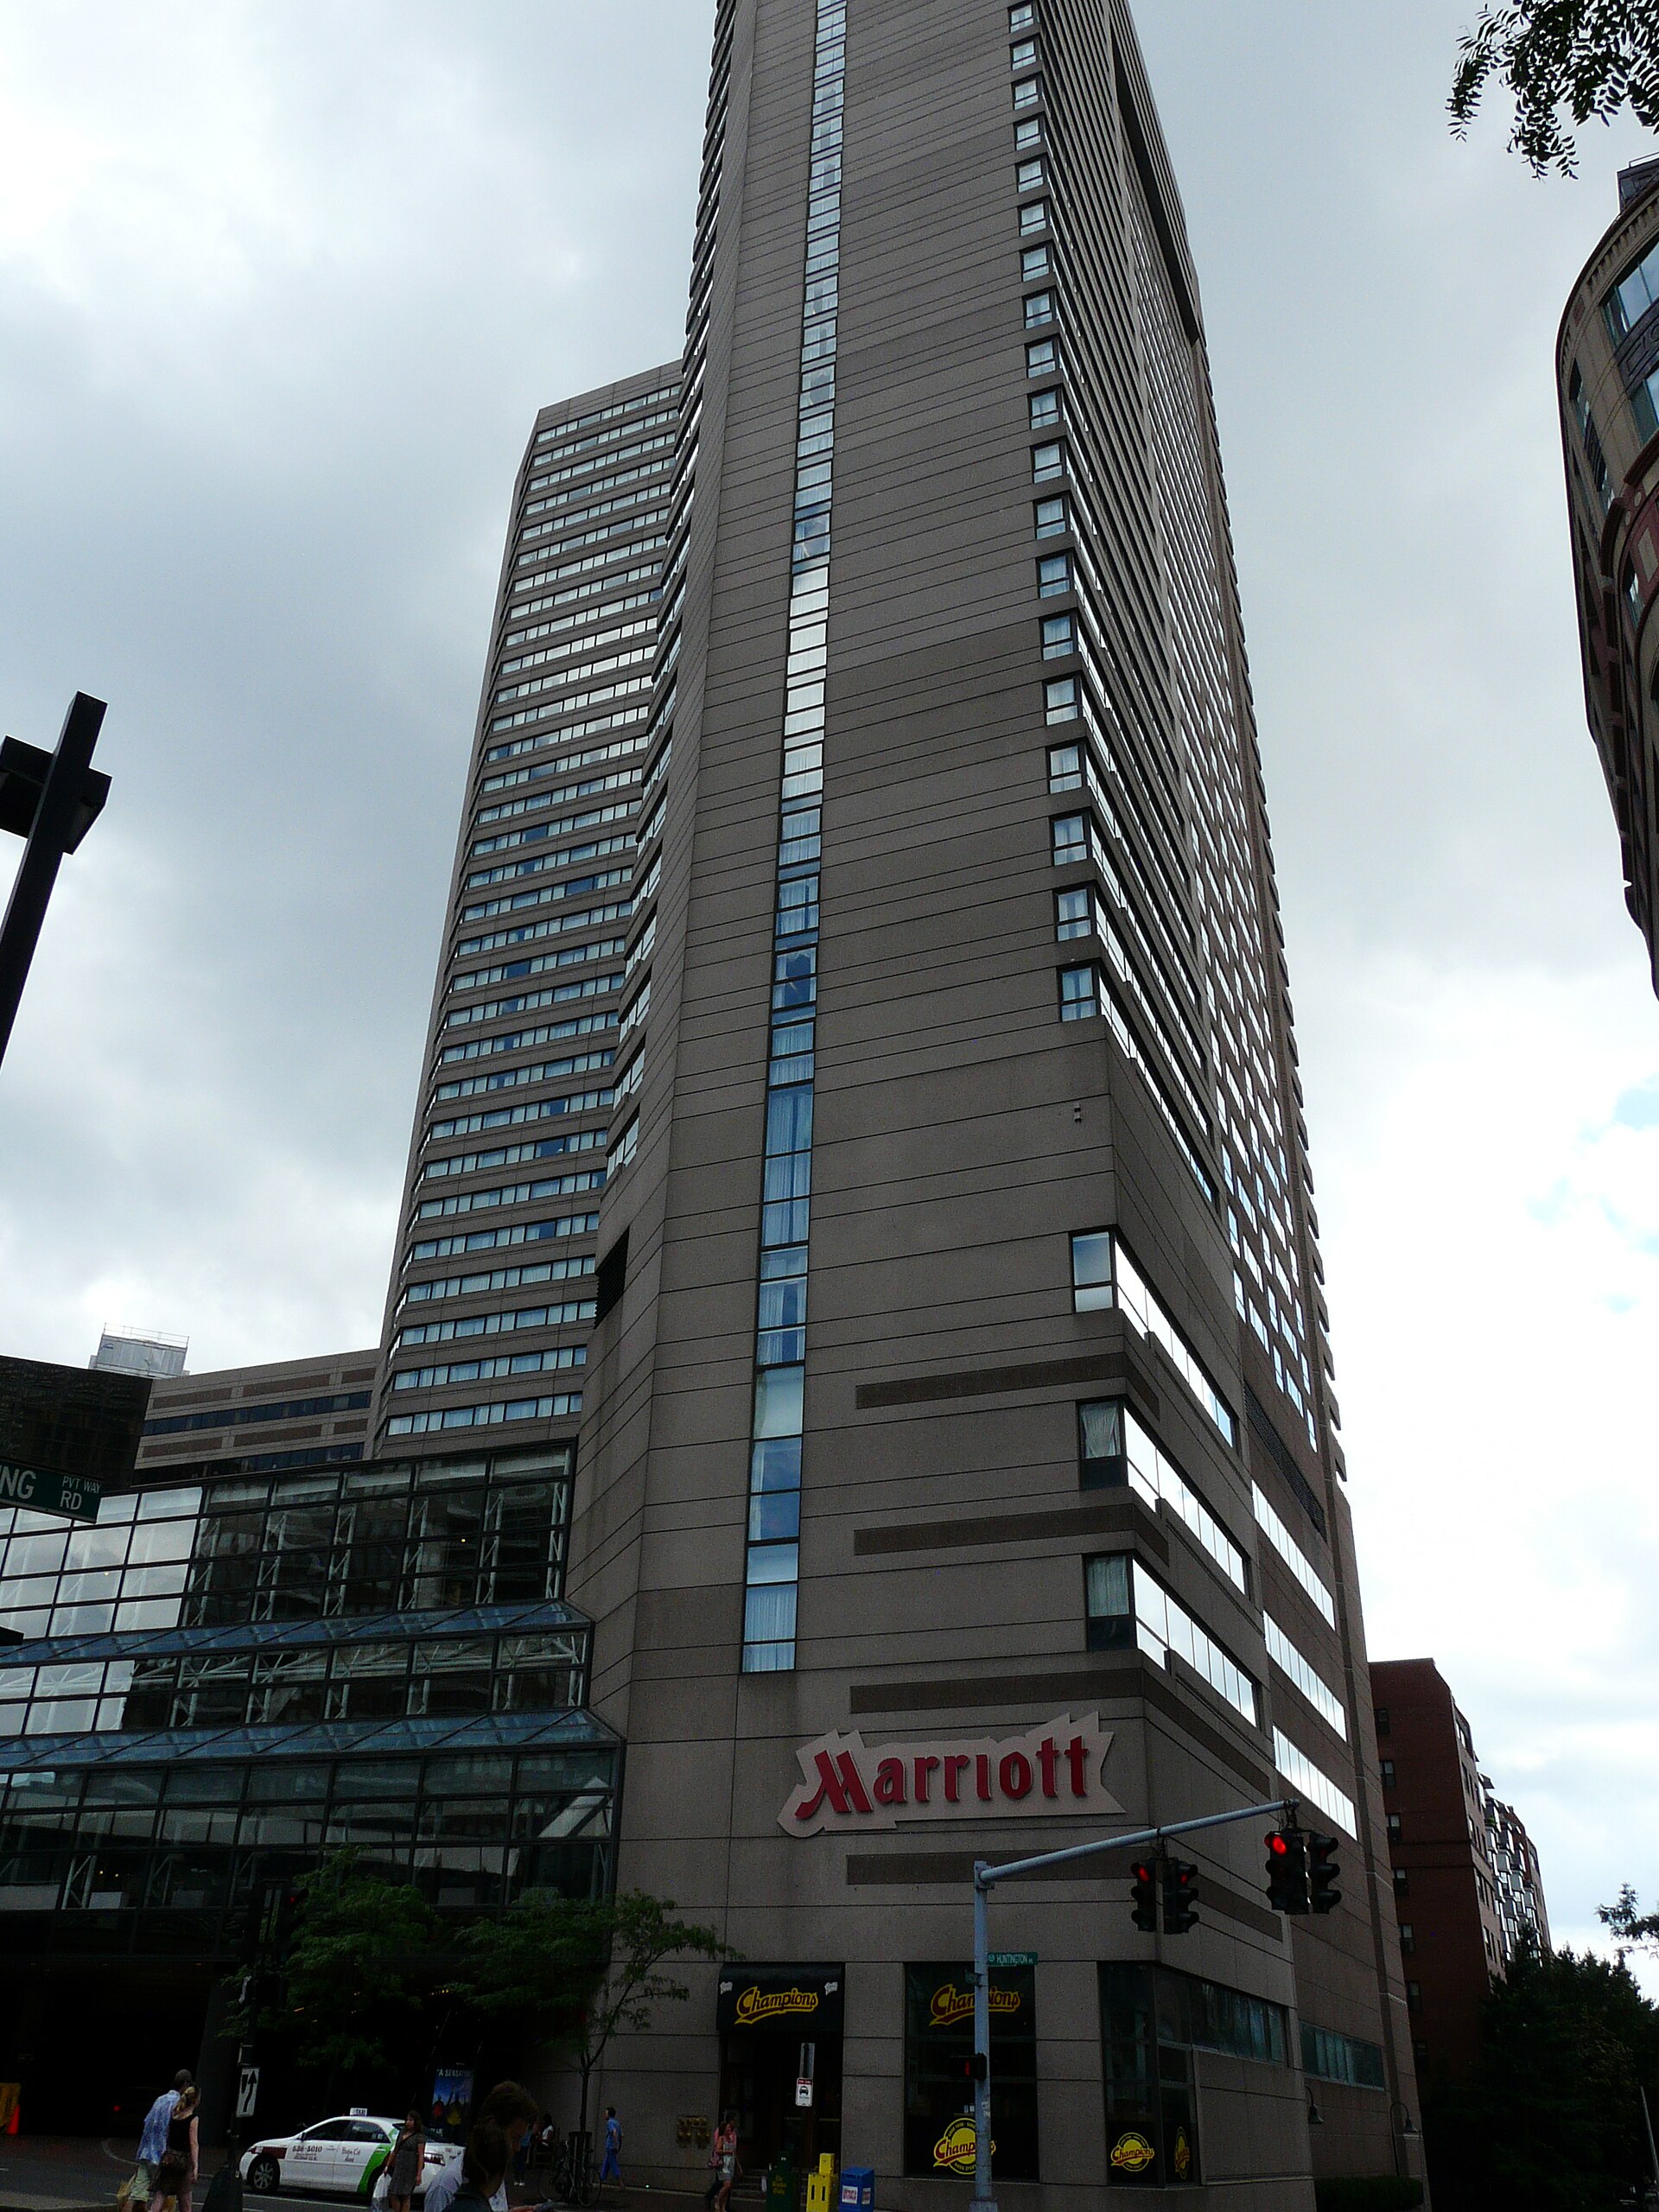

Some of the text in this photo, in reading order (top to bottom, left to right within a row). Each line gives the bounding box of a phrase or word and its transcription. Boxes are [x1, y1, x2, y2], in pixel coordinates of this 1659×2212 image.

[0, 1465, 83, 1510] NG RD
[62, 1476, 102, 1494] PVT WAY
[794, 1735, 1089, 1821] Marriott
[734, 1986, 819, 2024] Champions
[929, 1983, 1020, 2025] Chamions
